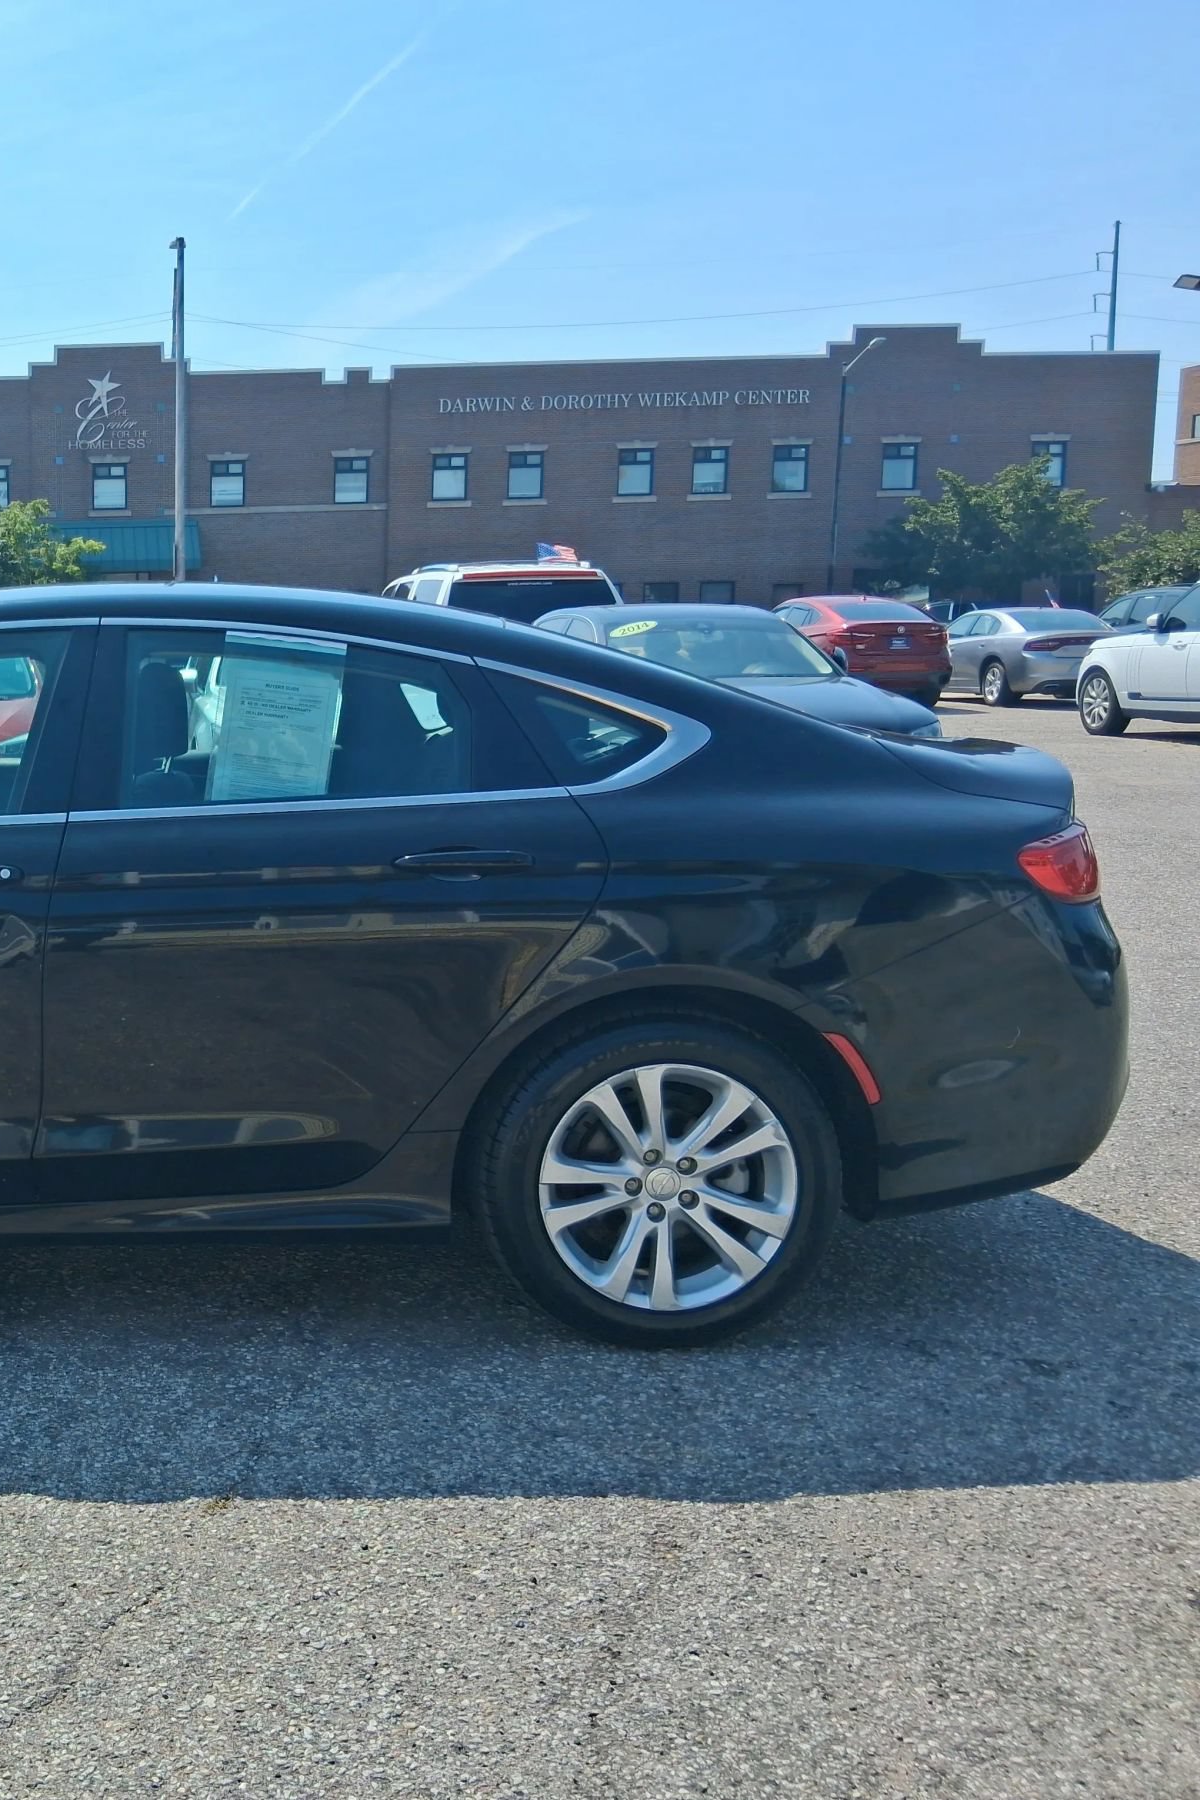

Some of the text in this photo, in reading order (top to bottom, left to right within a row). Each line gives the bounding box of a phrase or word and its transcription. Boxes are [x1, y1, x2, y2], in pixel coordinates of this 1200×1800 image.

[439, 389, 811, 413] DARWIN & DOROTHY WIEKAMP CENTER
[113, 408, 129, 417] THE
[112, 429, 151, 439] FOR THE
[68, 438, 146, 450] HOMELESS
[619, 622, 649, 636] 2014
